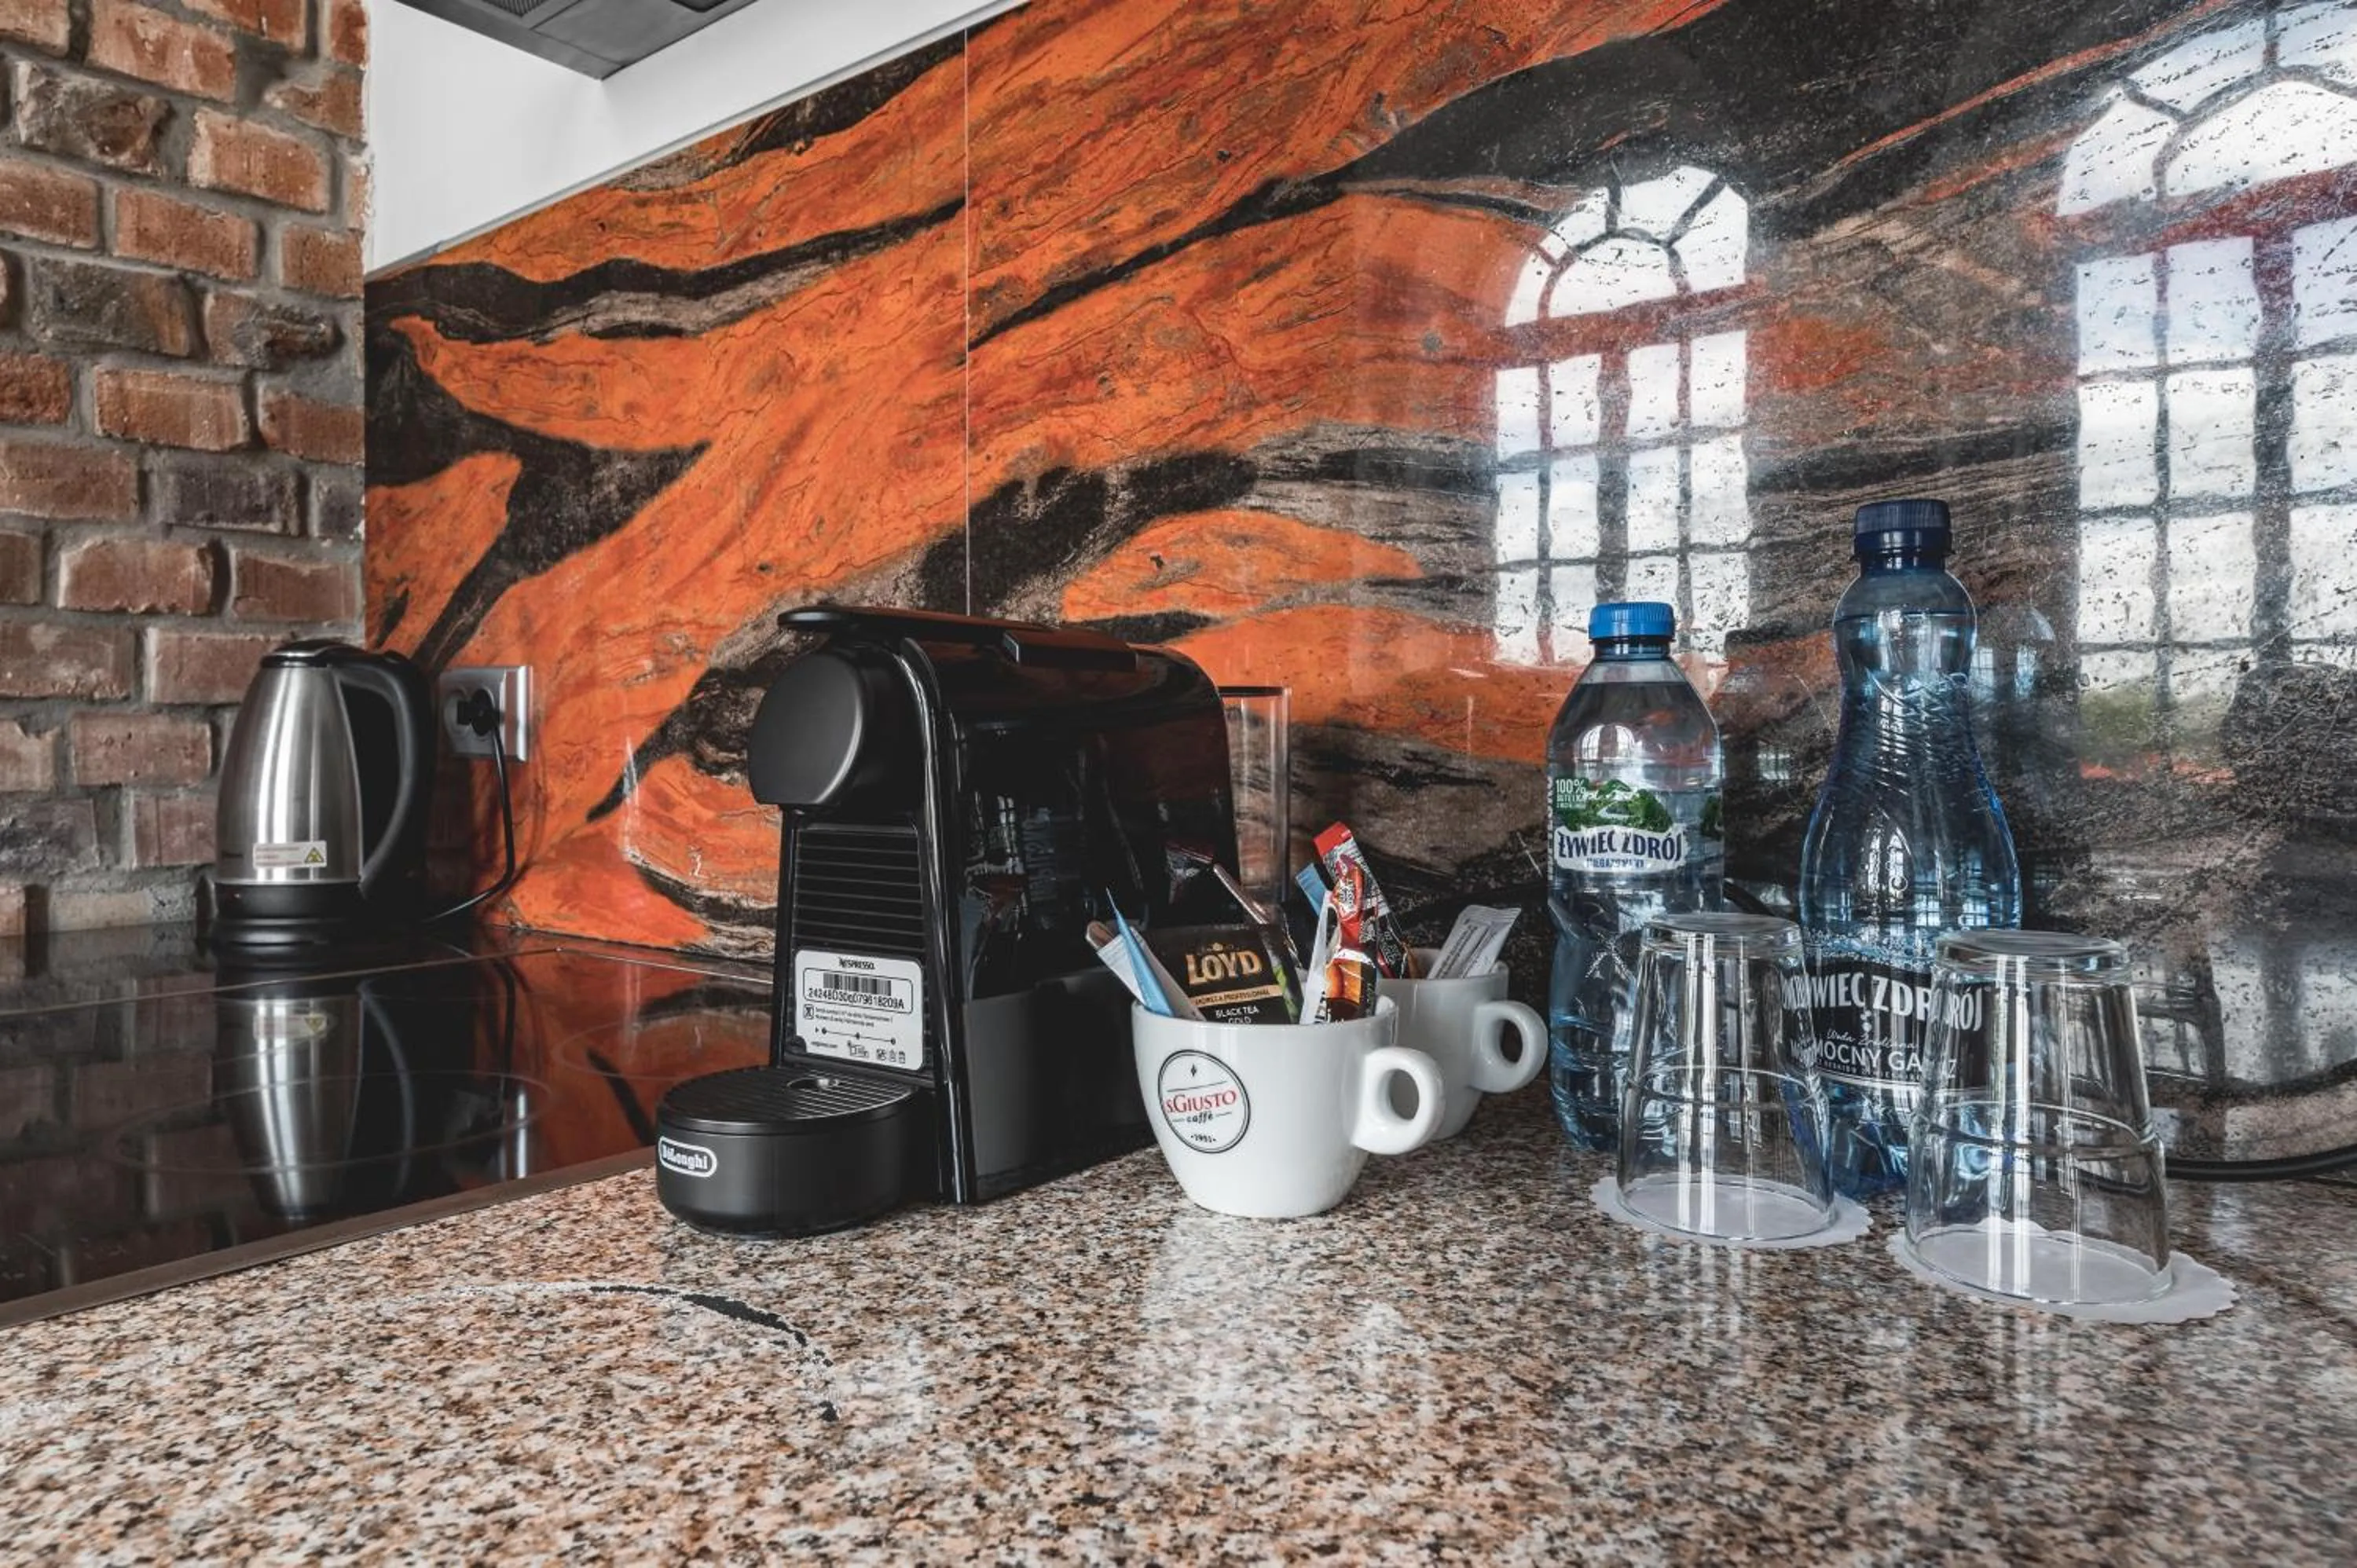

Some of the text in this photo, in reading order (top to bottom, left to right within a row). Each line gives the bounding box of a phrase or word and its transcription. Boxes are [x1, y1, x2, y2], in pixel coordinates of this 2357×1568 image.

[1556, 779, 1587, 794] 100%
[1621, 832, 1682, 863] ZDRÓJ
[1215, 1005, 1260, 1019] BLACK TEA
